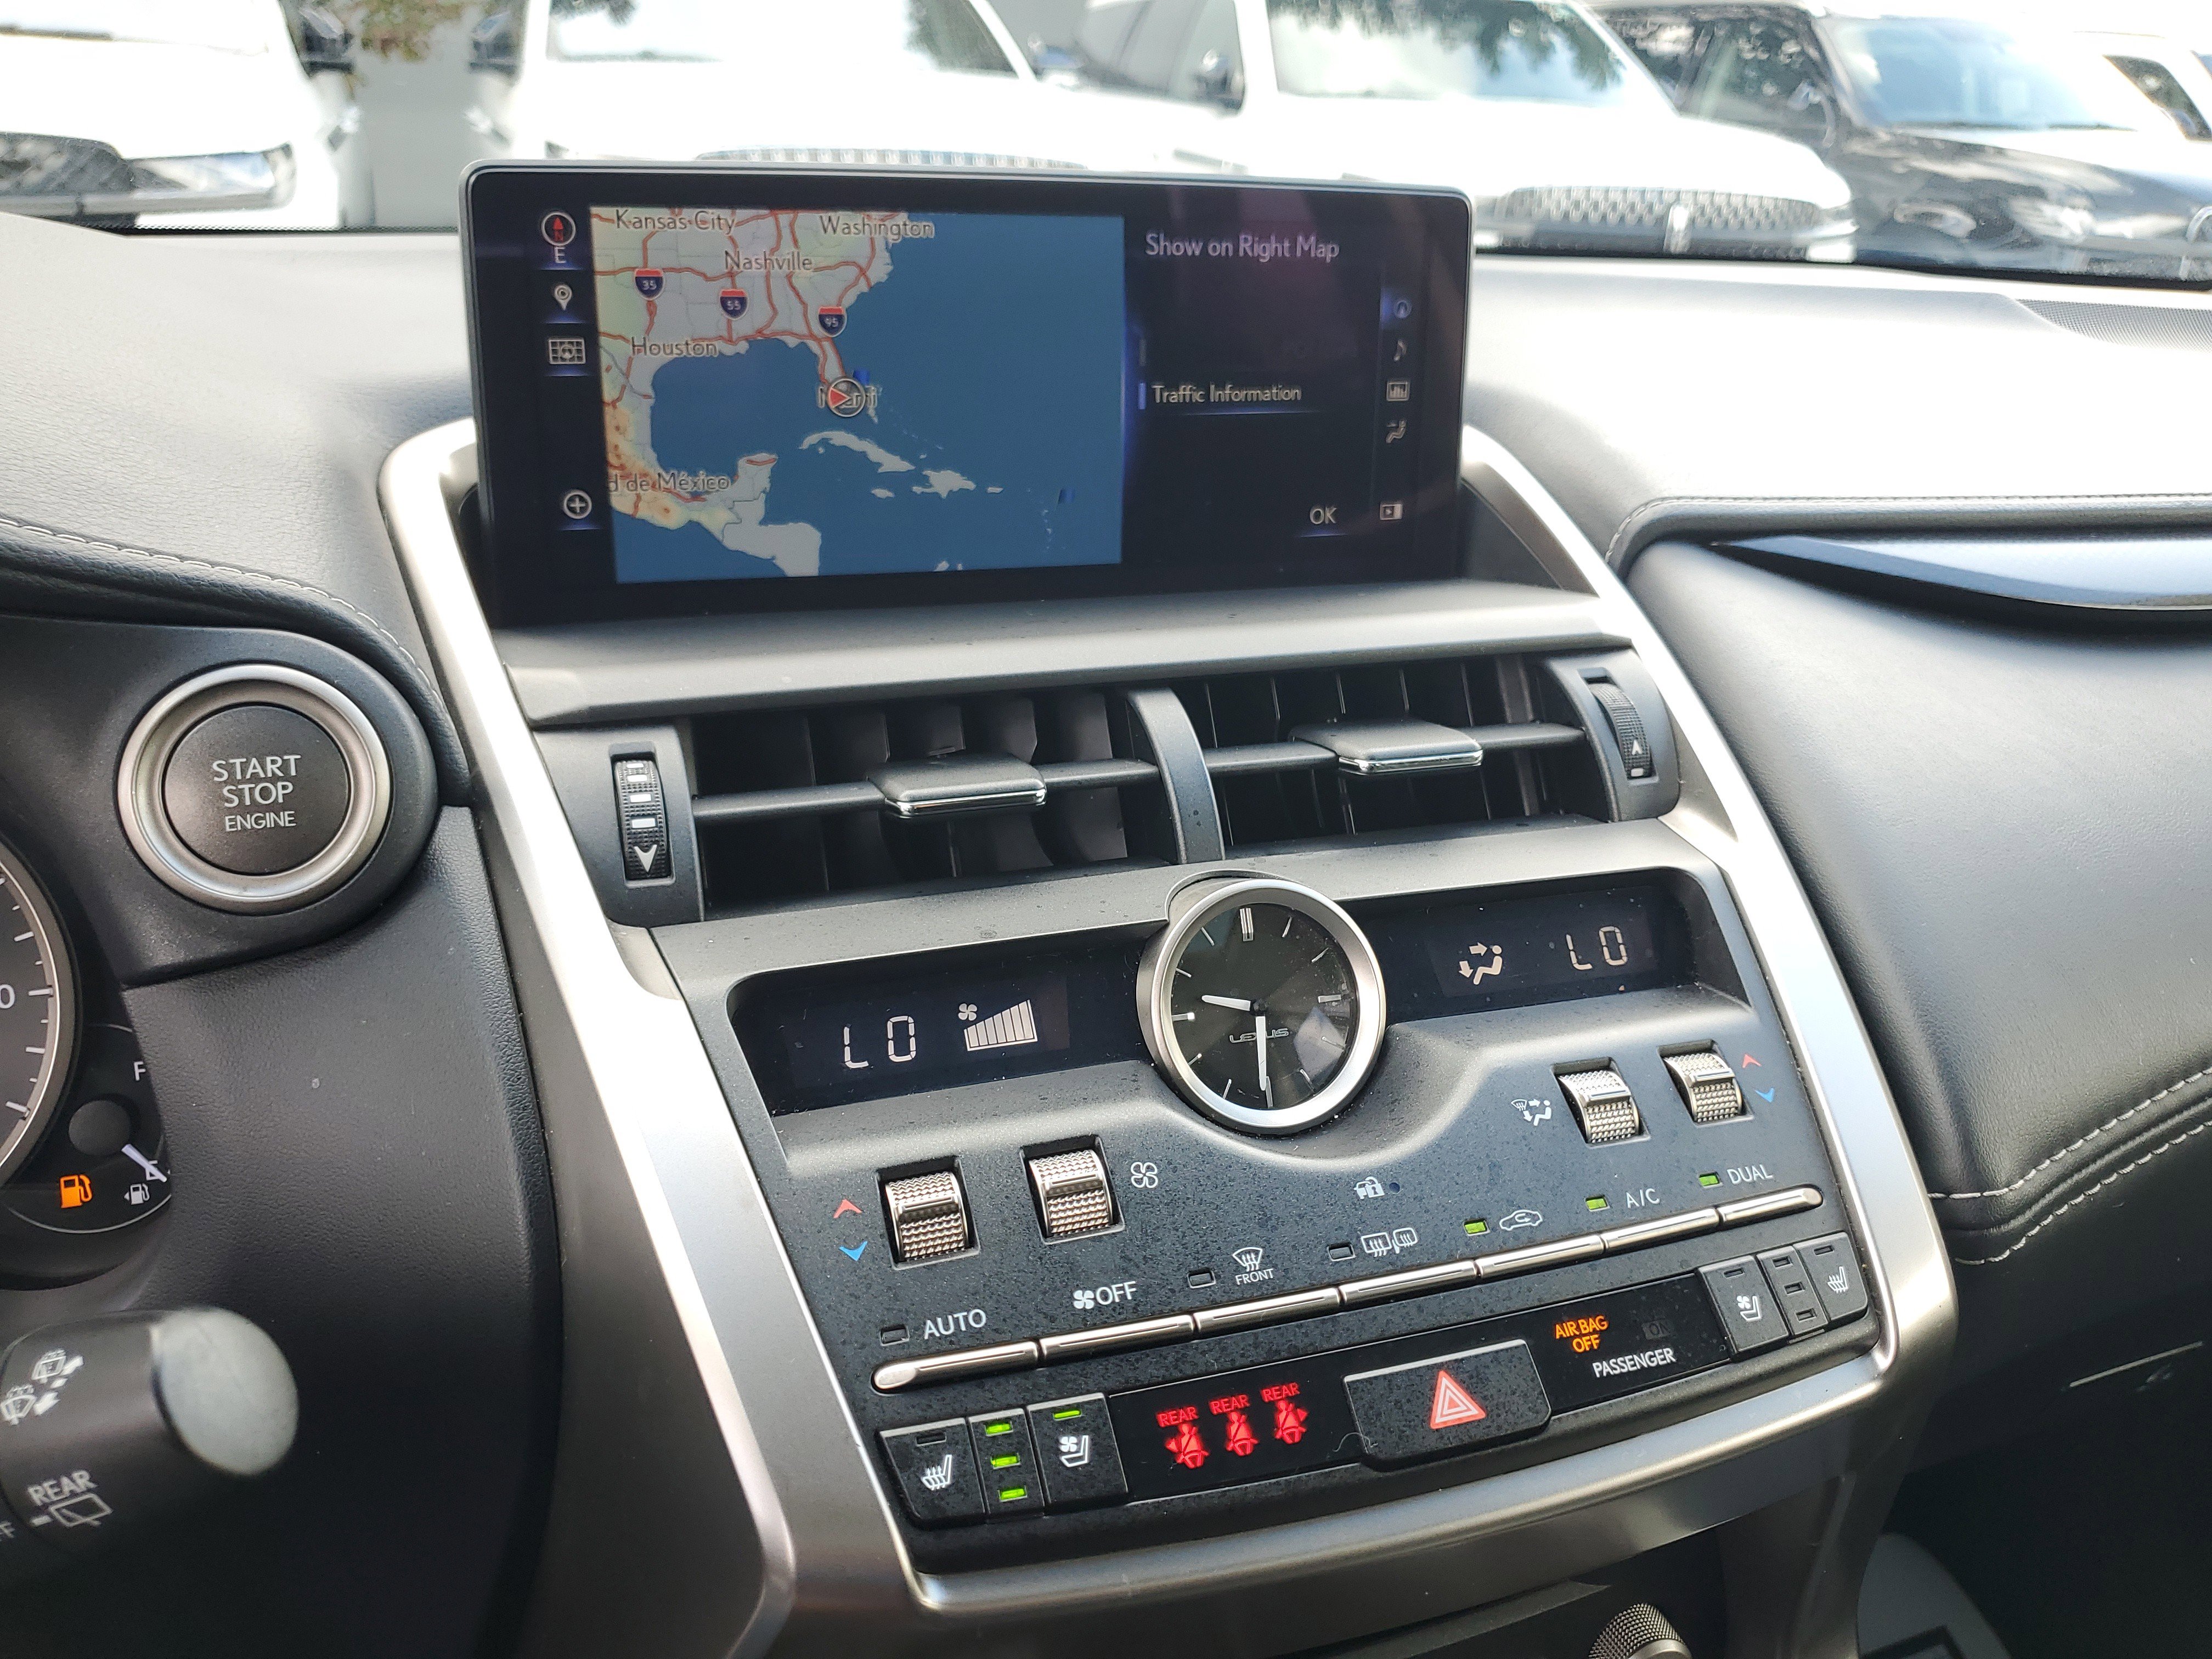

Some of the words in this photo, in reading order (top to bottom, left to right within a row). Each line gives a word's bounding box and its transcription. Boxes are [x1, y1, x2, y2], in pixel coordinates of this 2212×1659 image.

[616, 209, 687, 229] Kansas
[695, 210, 736, 235] City
[820, 215, 934, 242] Washington
[555, 246, 567, 263] E
[1145, 233, 1204, 257] Show
[1207, 241, 1234, 257] on
[1238, 233, 1291, 263] Right
[1295, 234, 1340, 263] Map
[725, 250, 813, 271] Nashville
[642, 279, 658, 291] 35
[727, 301, 741, 311] 55
[825, 317, 839, 328] 95
[631, 336, 718, 357] Houston
[1151, 385, 1205, 403] Traffic
[1210, 383, 1302, 402] Information
[626, 473, 650, 492] de
[658, 471, 731, 492] México
[1310, 506, 1337, 525] OK
[212, 755, 301, 781] START
[222, 781, 294, 808] STOP
[224, 811, 297, 832] ENGINE
[1229, 1028, 1289, 1043] LEUS
[134, 1061, 146, 1081] F
[1726, 1164, 1773, 1185] DUAL
[1626, 1188, 1660, 1209] A/C
[1235, 1268, 1274, 1285] FRONT
[1096, 1280, 1137, 1305] OFF
[923, 1308, 986, 1340] AUTO
[1572, 1334, 1601, 1353] OFF
[1592, 1347, 1676, 1378] PASSENGER
[1261, 1381, 1300, 1403] REAR
[1209, 1394, 1250, 1415] REAR
[1156, 1406, 1200, 1427] REAR
[27, 1469, 98, 1506] REAR
